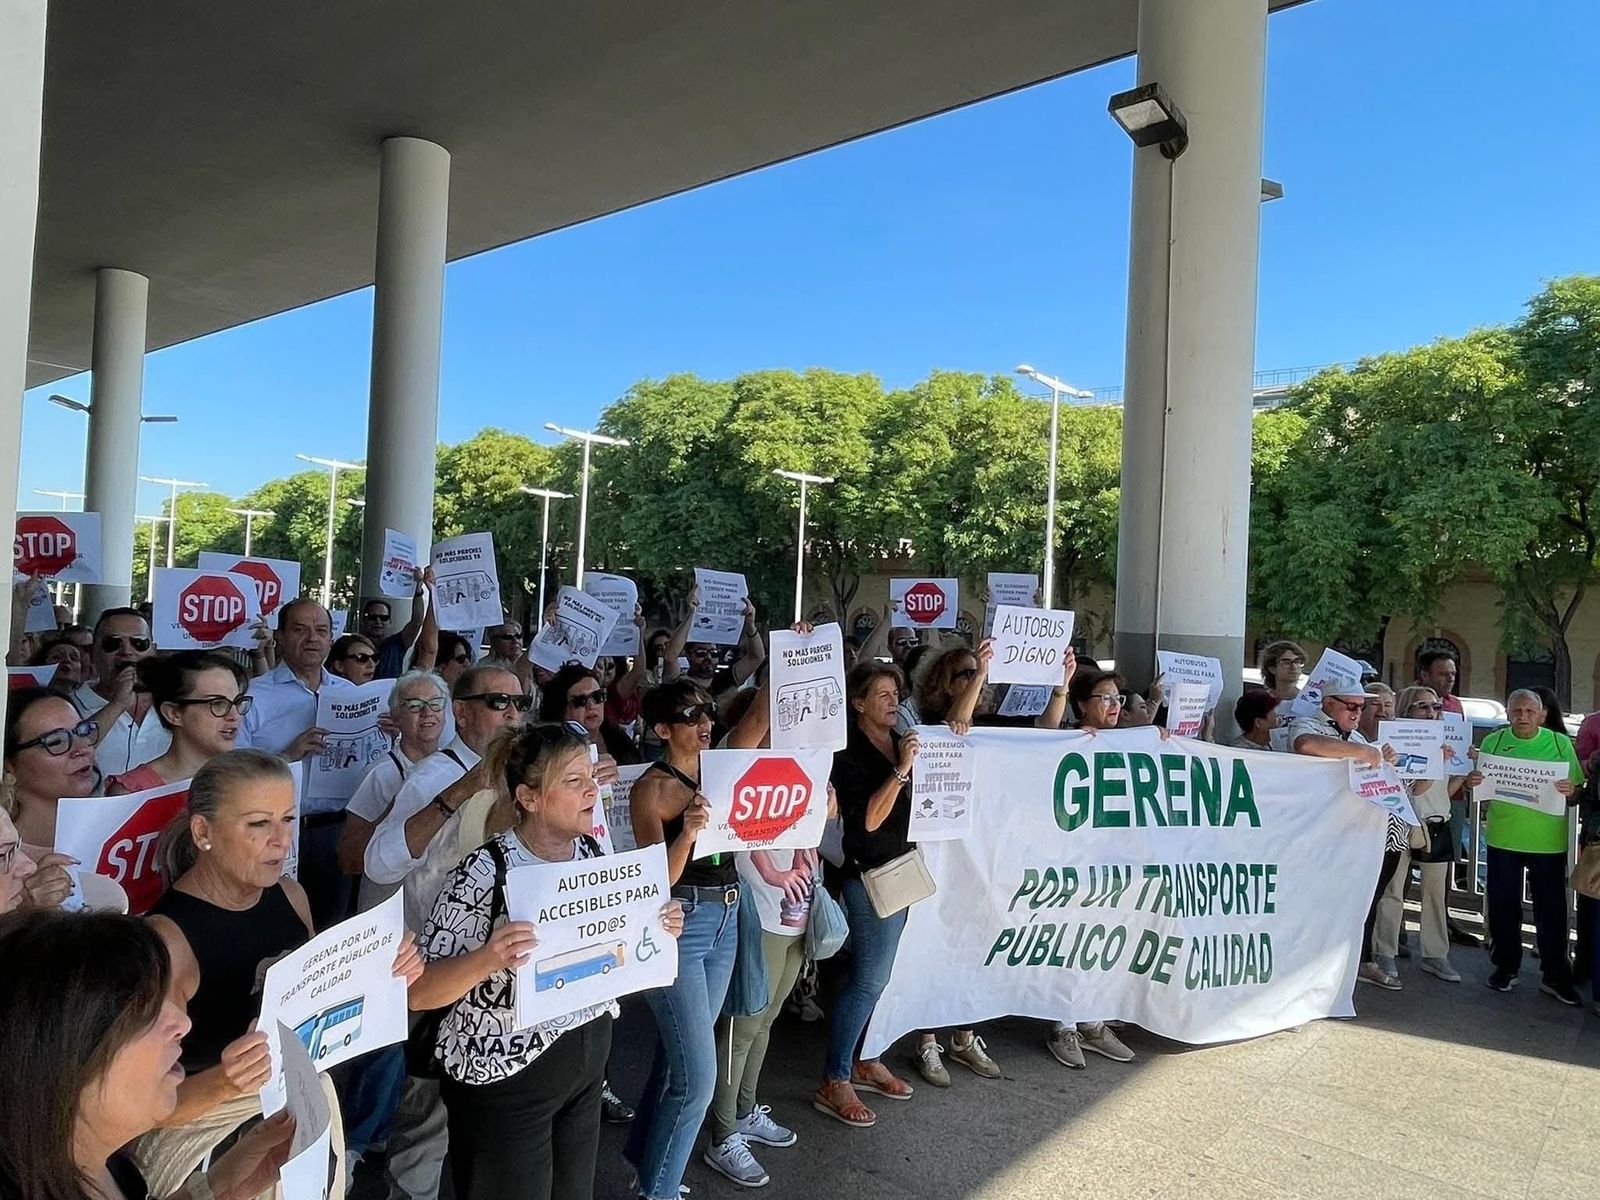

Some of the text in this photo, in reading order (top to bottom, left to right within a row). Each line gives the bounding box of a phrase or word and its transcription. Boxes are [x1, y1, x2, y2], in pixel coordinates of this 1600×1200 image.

[183, 594, 243, 623] STOP
[906, 593, 943, 612] STOP
[1002, 614, 1065, 638] AUTOBUS
[782, 650, 793, 659] NO
[809, 643, 833, 656] PARCHES
[787, 654, 824, 667] SOLUCIONES
[1482, 762, 1556, 777] ACABEN CON LAS
[1053, 752, 1262, 832] GERENA
[1496, 780, 1539, 790] RETRASOS
[735, 784, 807, 821] STOP
[746, 838, 775, 849] DIGNO
[558, 863, 642, 893] AUTOBUSES
[1007, 862, 1278, 918] POR UN TRANSPORTE
[538, 883, 660, 924] ACCESIBLES PARA
[577, 915, 627, 939] TOD@S
[302, 925, 378, 972] GERENA POR UN
[983, 913, 1273, 991] PÚBLICO DE CALIDAD
[280, 962, 338, 1006] TRANSPORTE
[380, 932, 393, 947] DE
[310, 969, 352, 999] CALIDAD
[465, 1032, 546, 1057] NASA
